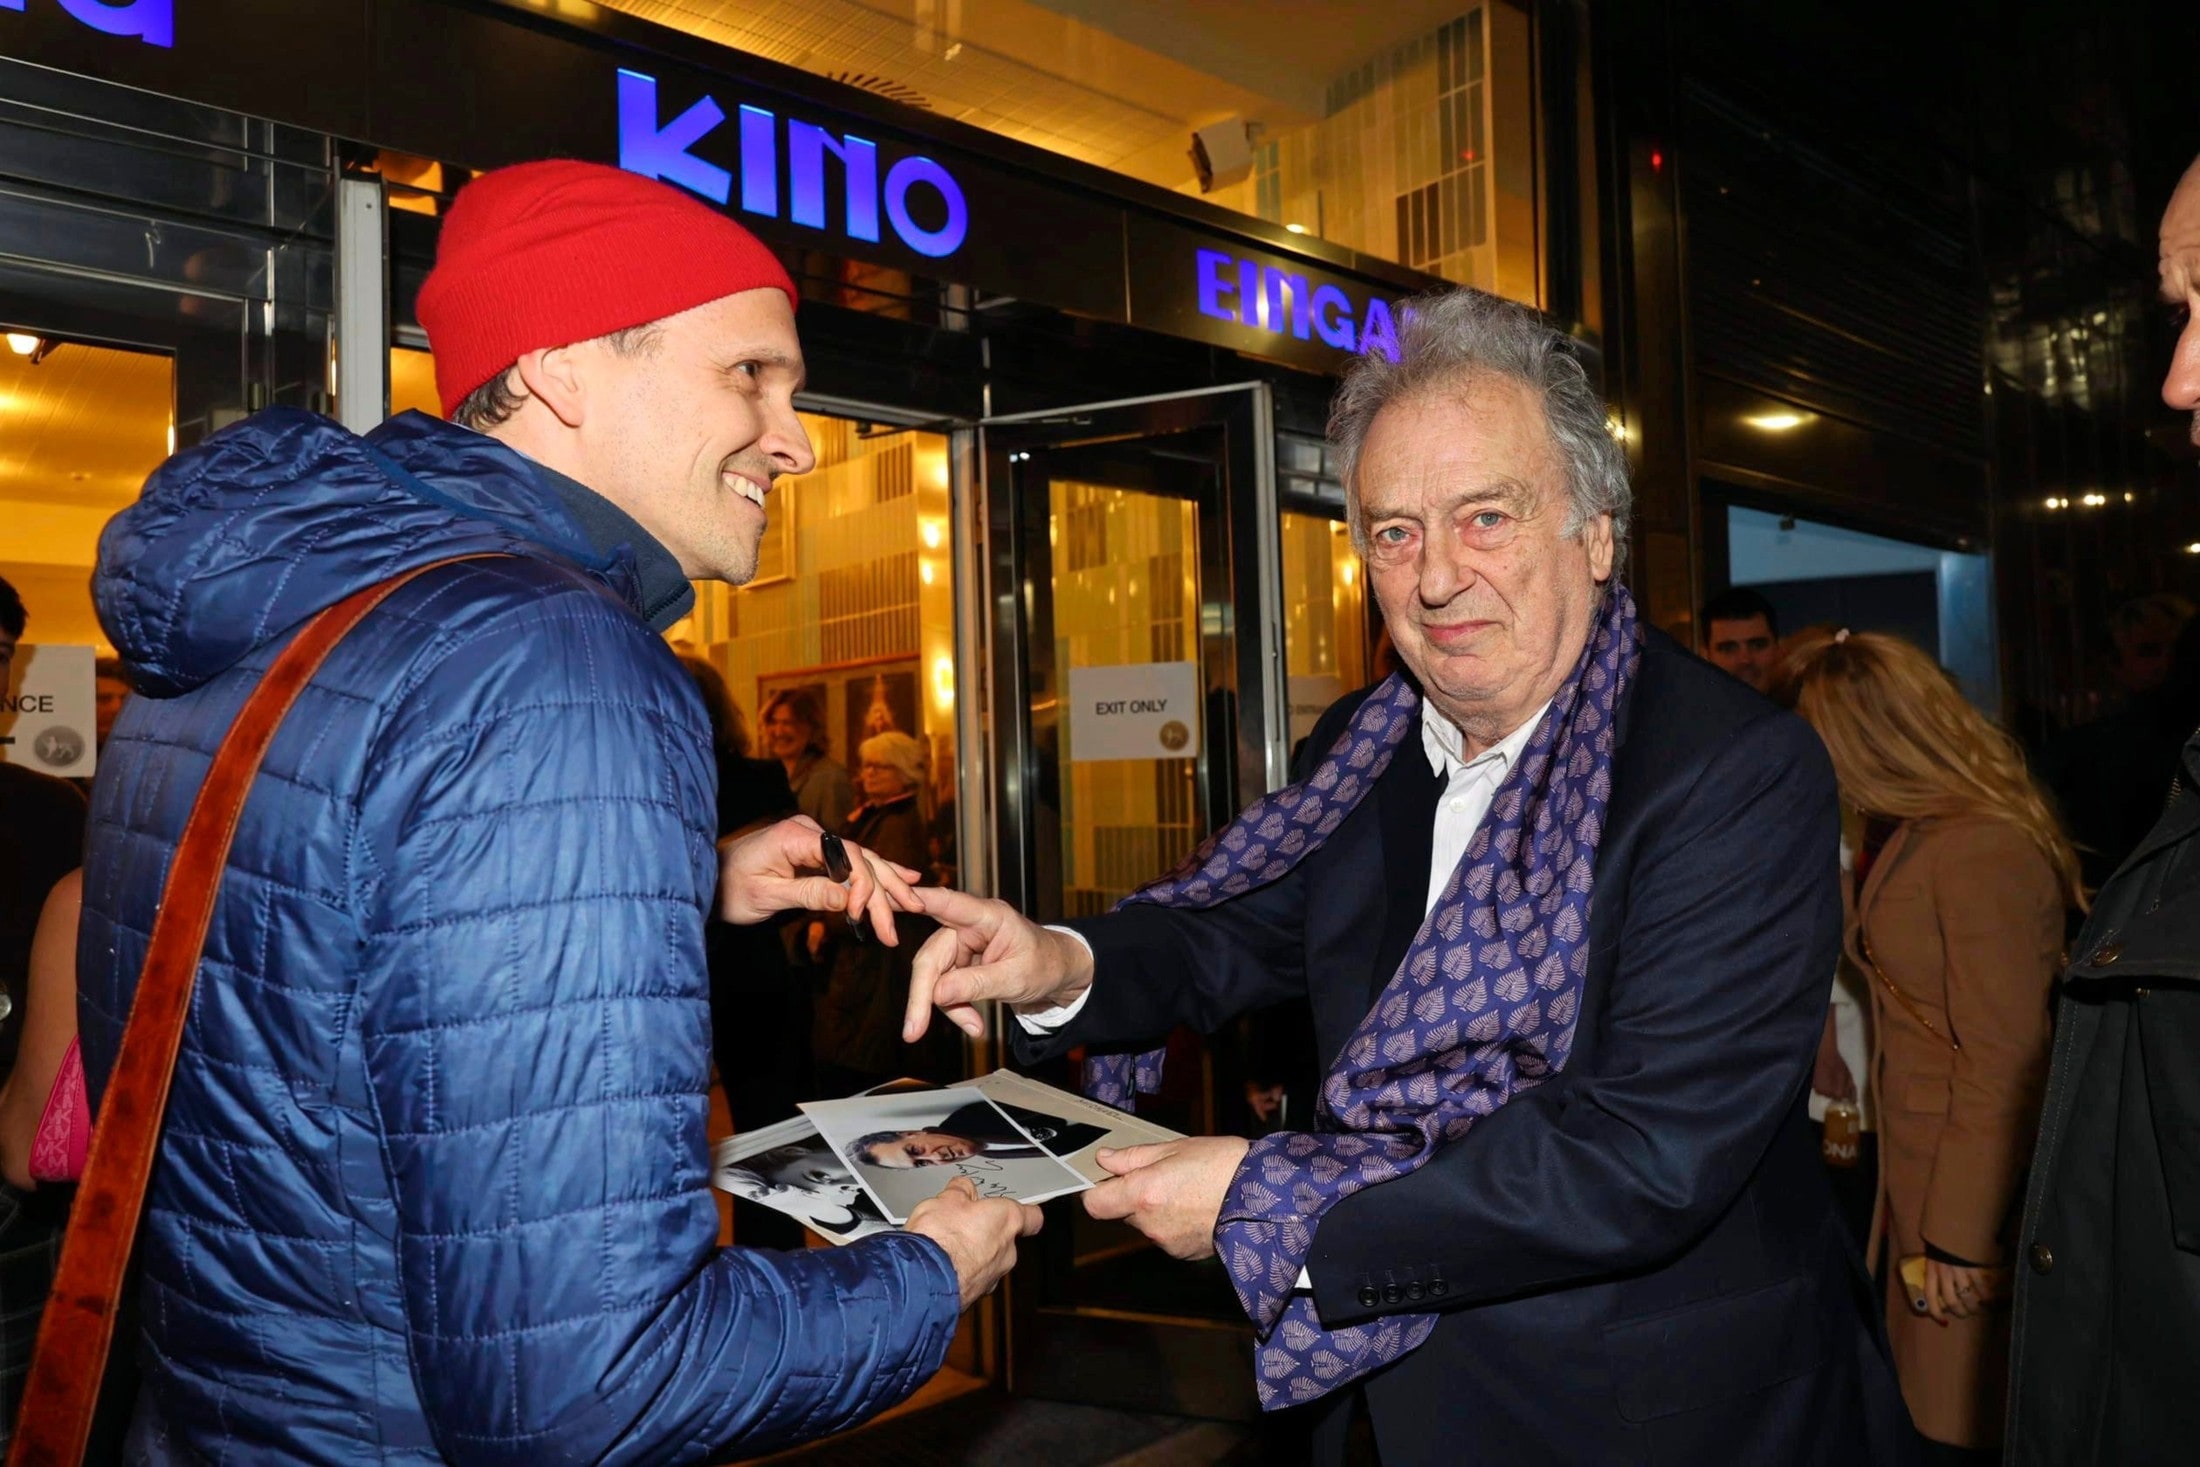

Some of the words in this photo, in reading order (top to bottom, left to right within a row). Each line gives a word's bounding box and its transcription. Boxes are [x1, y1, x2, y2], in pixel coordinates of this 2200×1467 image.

[617, 67, 968, 258] KINO
[1196, 247, 1404, 364] EINGA
[1096, 701, 1126, 716] EXIT
[1130, 699, 1168, 714] ONLY
